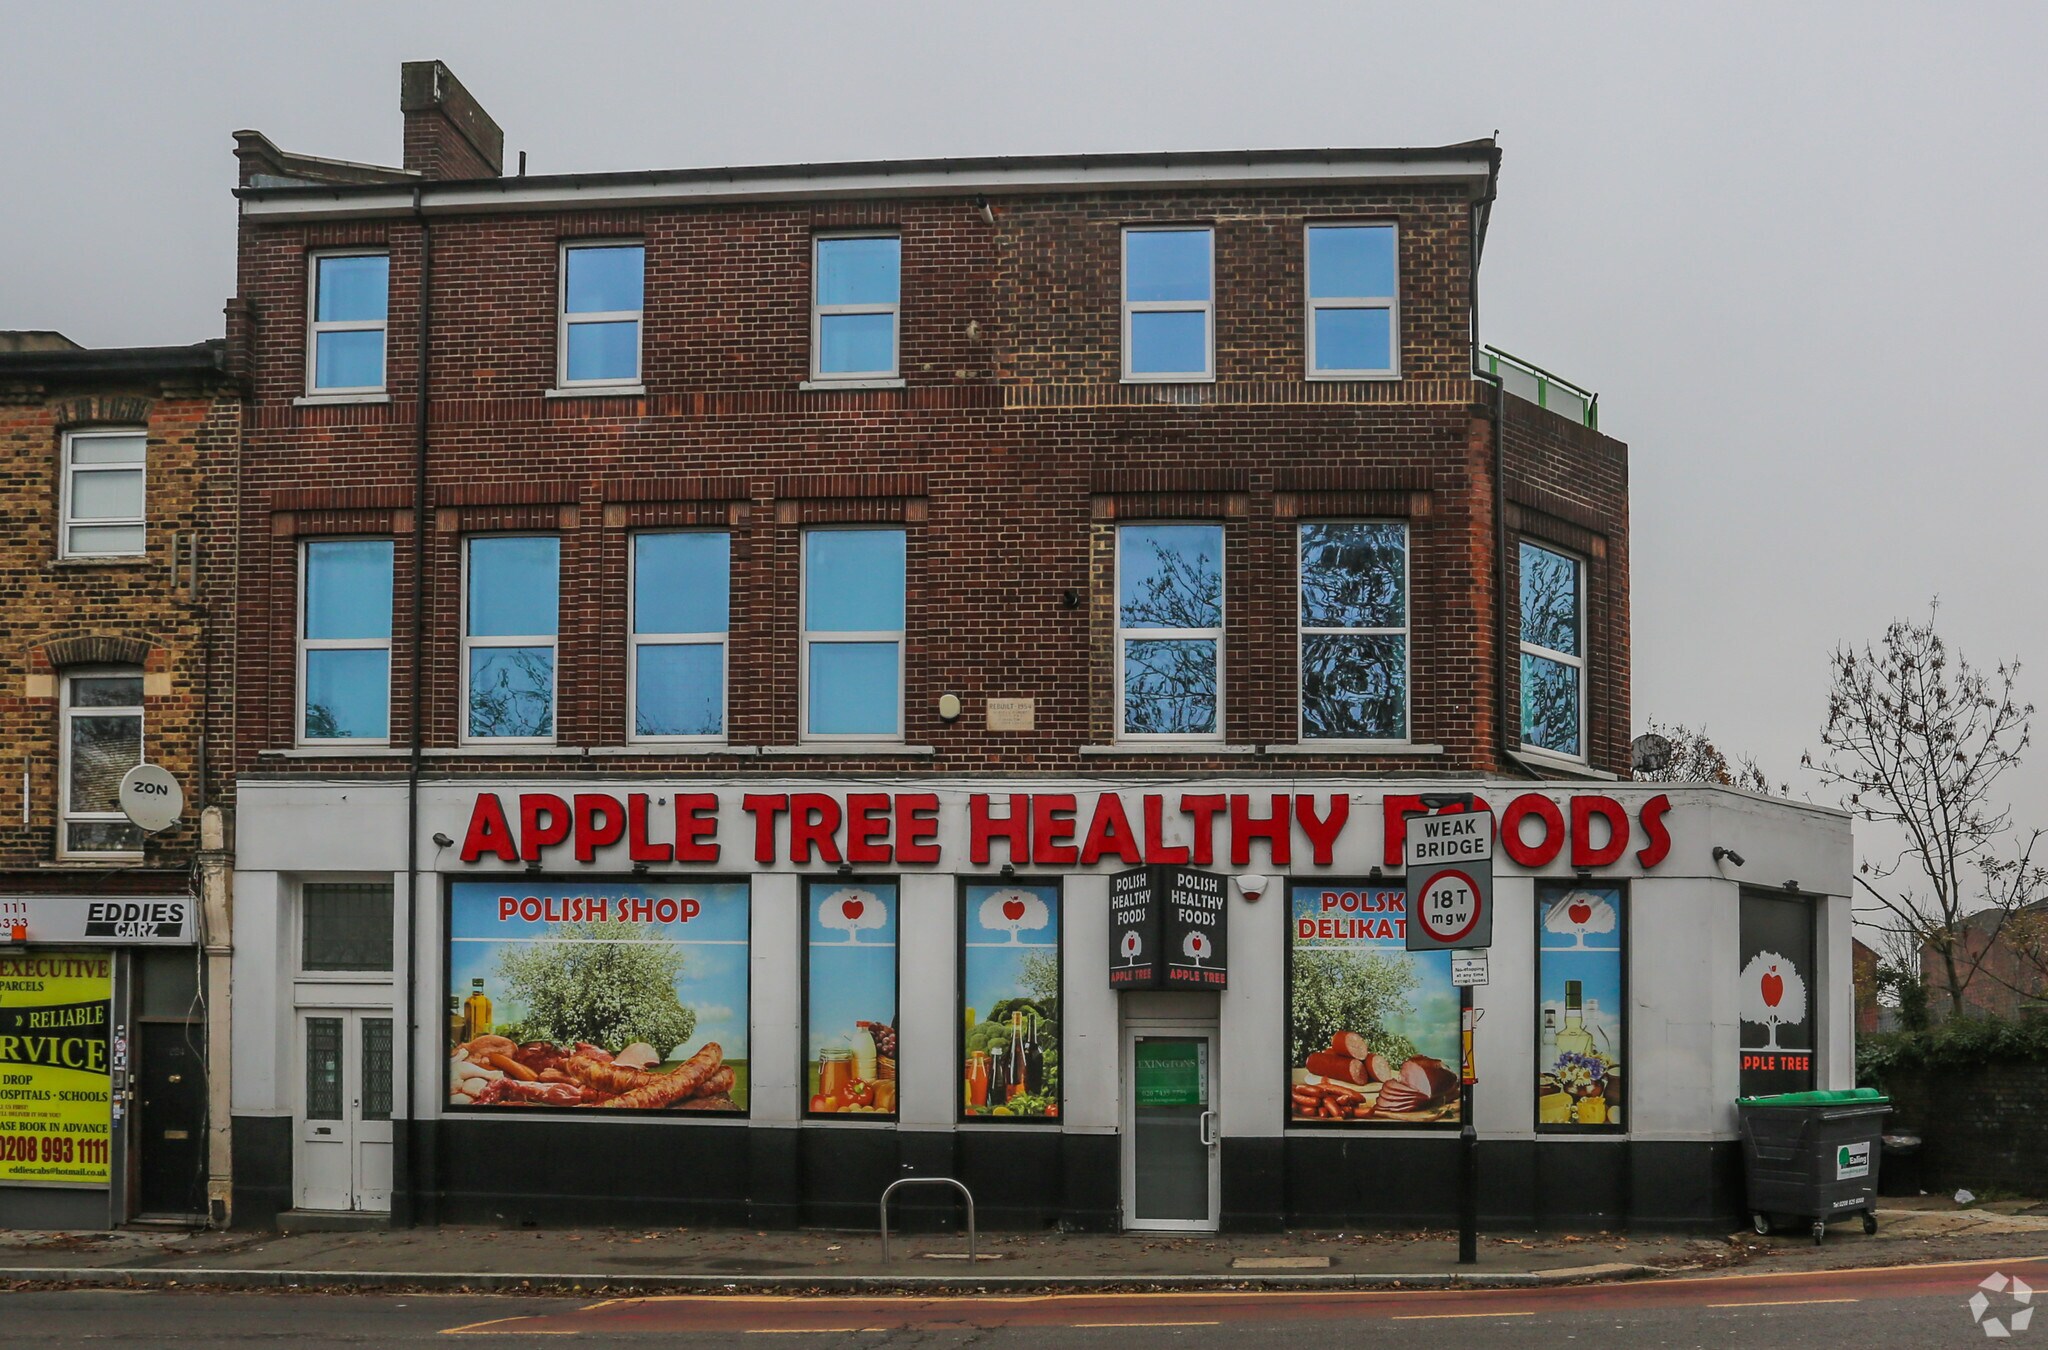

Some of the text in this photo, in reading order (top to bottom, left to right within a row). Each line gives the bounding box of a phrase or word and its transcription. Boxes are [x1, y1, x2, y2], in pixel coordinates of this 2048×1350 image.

[134, 782, 168, 796] ZON
[460, 793, 720, 862] APPLE
[743, 793, 942, 863] TREE
[969, 793, 1349, 865] HEALTHY
[1424, 818, 1476, 838] WEAK
[1416, 838, 1484, 858] BRIDGE
[1116, 873, 1147, 892] POLISH
[1177, 873, 1218, 893] POLISH
[1112, 889, 1151, 910] HEALTHY
[1171, 889, 1224, 911] HEALTHY
[87, 903, 185, 922] EDDIES
[498, 896, 701, 924] POLISH SHOP
[1117, 908, 1146, 926] FOODS
[1178, 908, 1216, 927] FOODS
[115, 922, 159, 937] CARZ
[0, 959, 109, 979] EXECUTIVE
[1111, 969, 1151, 983] APPLE TREE
[1170, 968, 1225, 983] APPLE TREE
[29, 1006, 104, 1028] RELIABLE
[1781, 1056, 1809, 1070] TREE
[3, 1075, 33, 1085] DROP
[0, 1089, 108, 1102] OSPITALS SCHOOLS
[19, 1122, 47, 1132] BOOK
[49, 1123, 60, 1132] IN
[62, 1124, 109, 1133] ADVANCE
[41, 1136, 74, 1164] 993
[77, 1138, 109, 1164] 1111
[8, 1166, 108, 1177] eddiescabs@hotmail.co.uk
